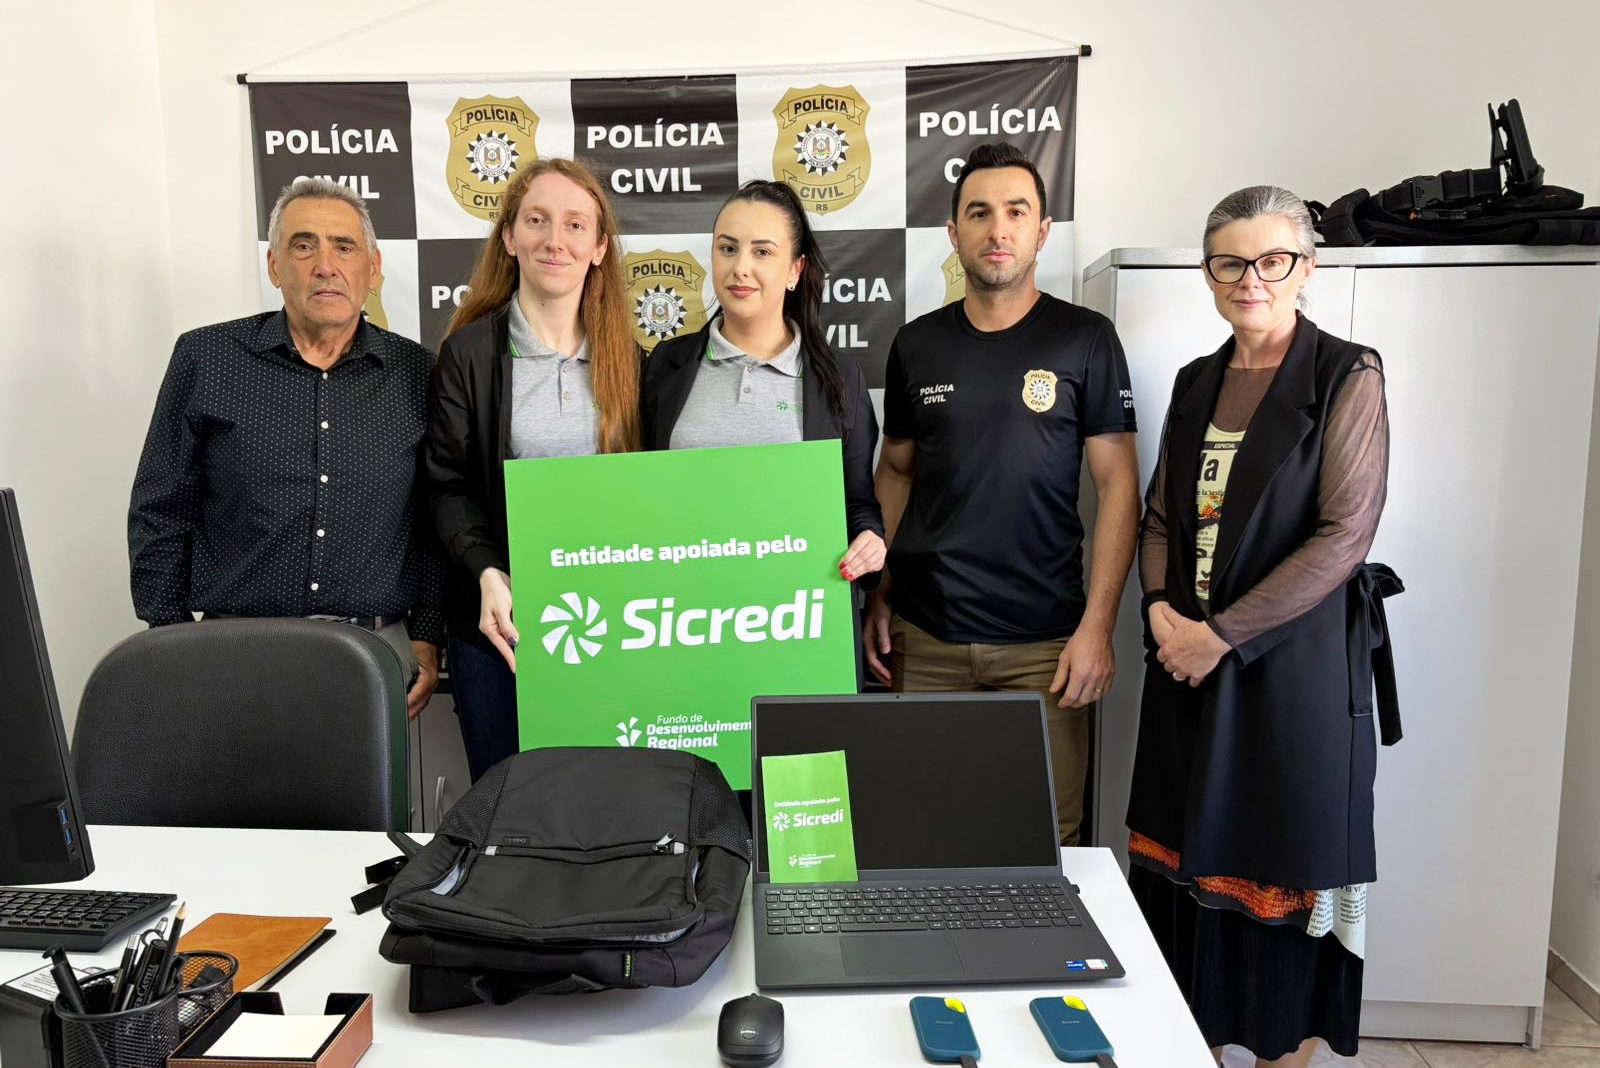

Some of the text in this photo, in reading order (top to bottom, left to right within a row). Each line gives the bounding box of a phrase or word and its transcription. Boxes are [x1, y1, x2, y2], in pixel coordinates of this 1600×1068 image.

[466, 106, 519, 124] POLÍCIA
[794, 95, 849, 115] POLÍCIA
[919, 103, 1062, 137] POLÍCIA
[265, 123, 399, 155] POLÍCIA
[586, 118, 725, 149] POLÍCIA
[610, 167, 702, 194] CIVIL
[473, 194, 503, 207] CIV
[800, 185, 844, 199] CIVIL
[632, 259, 686, 279] POLÍCIA
[822, 273, 892, 303] ÍCIA
[920, 383, 954, 396] POLÍCIA
[923, 394, 947, 405] CIVIL
[551, 534, 808, 567] Entidade apoiada pelo
[621, 588, 825, 650] Sicredi
[646, 720, 751, 736] Desenvolviment
[657, 713, 703, 725] Fundo de
[647, 733, 718, 750] Regional
[793, 809, 844, 827] Sicredi
[134, 963, 159, 1007] ER-CASTELL
